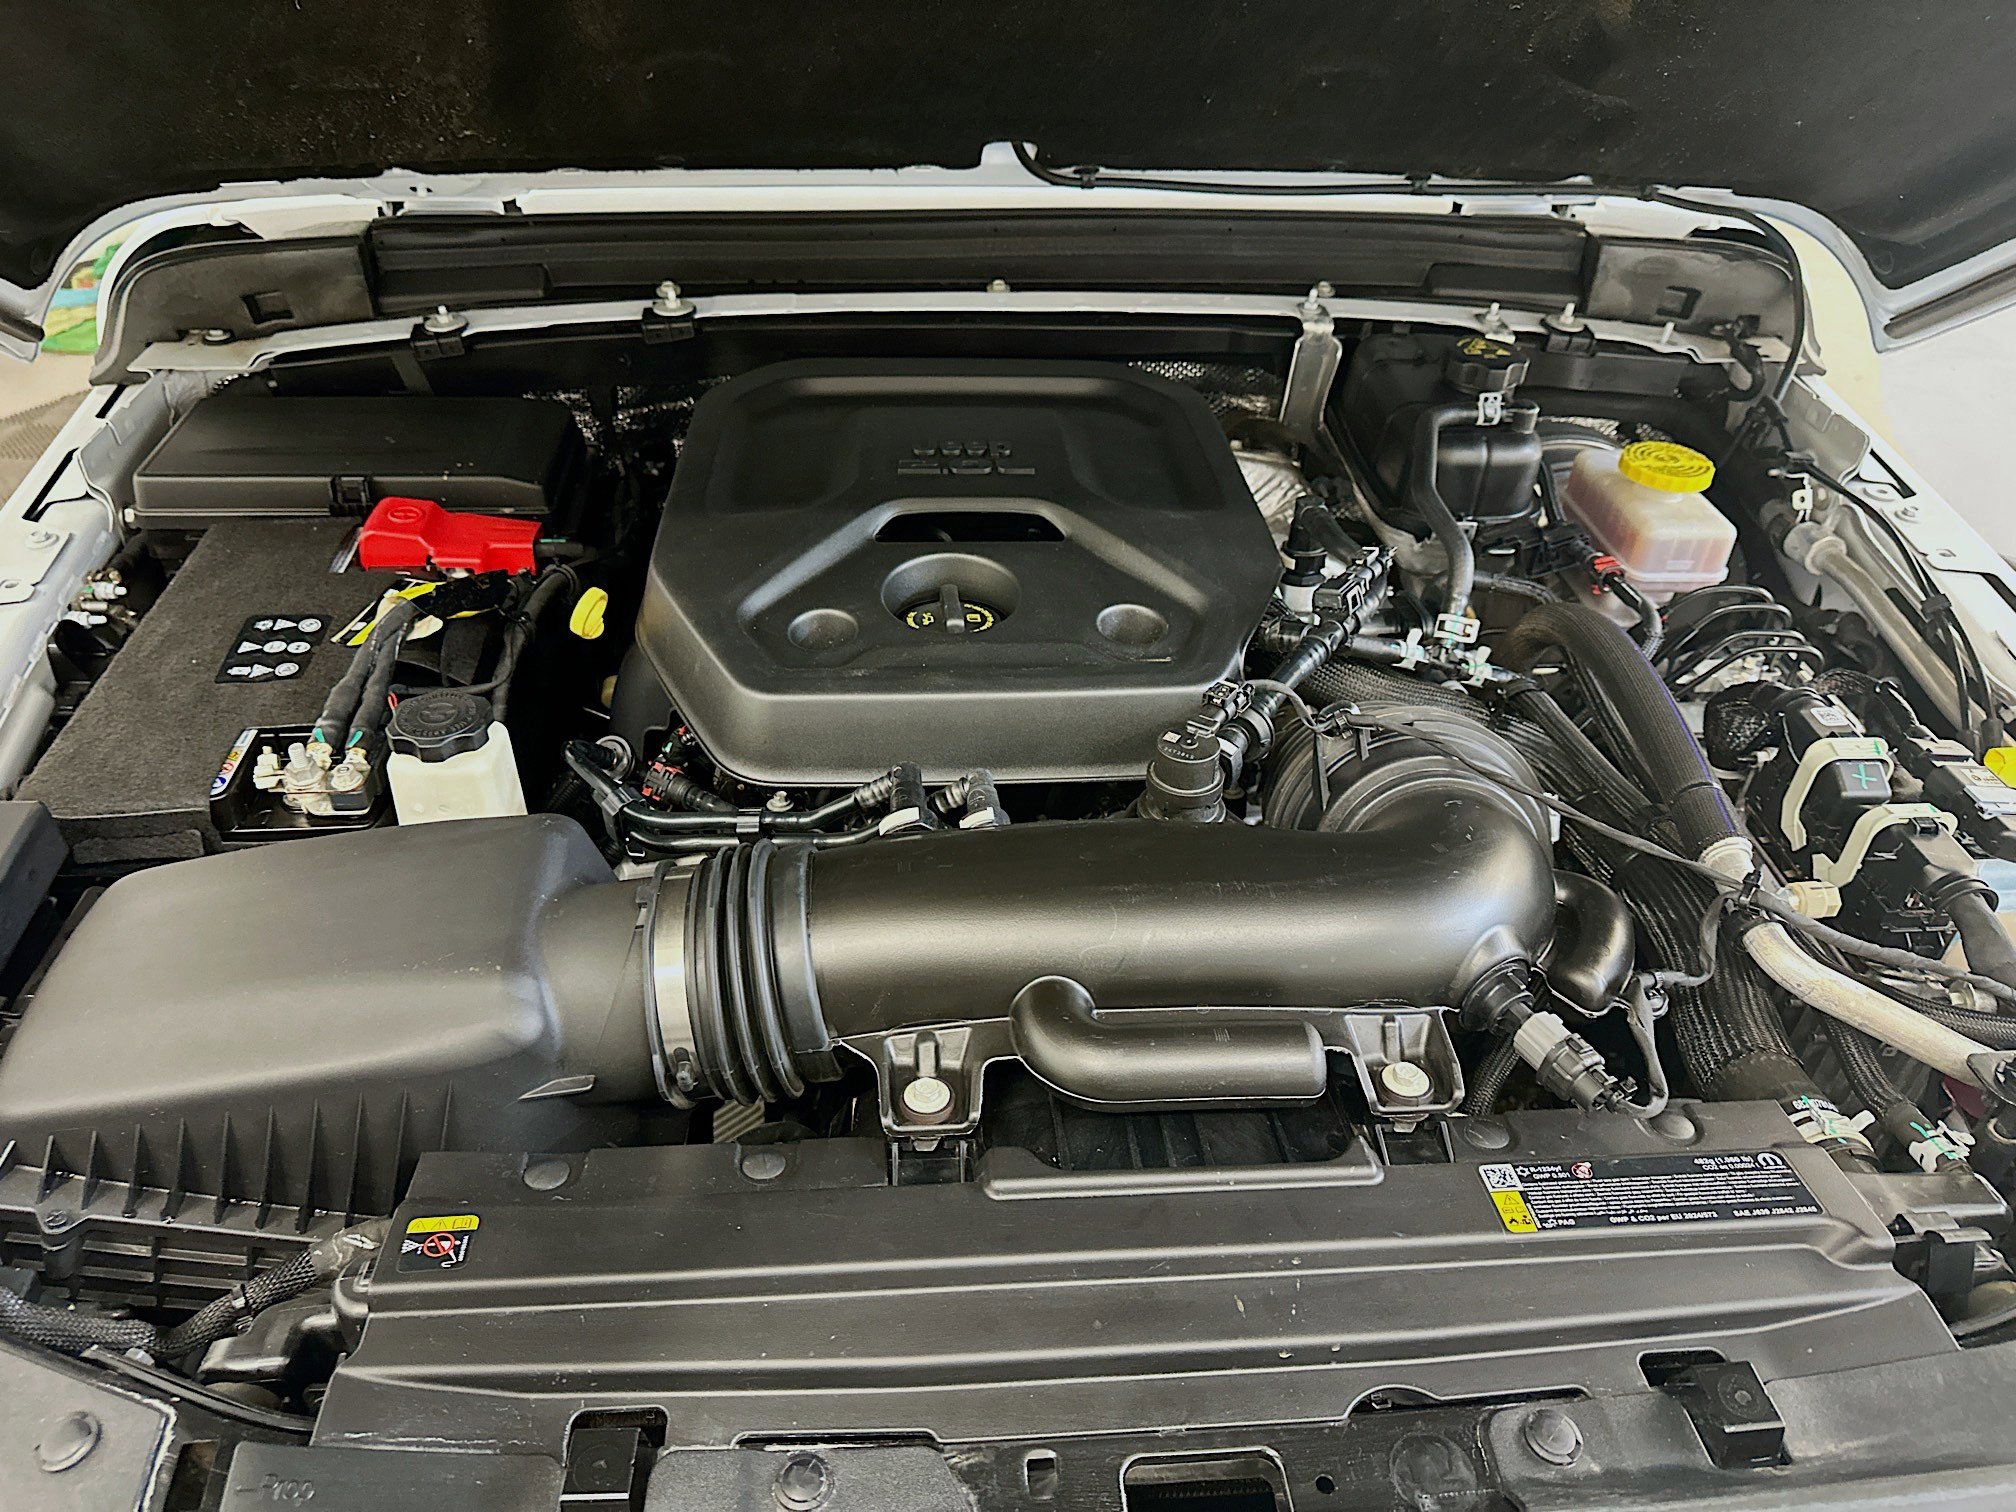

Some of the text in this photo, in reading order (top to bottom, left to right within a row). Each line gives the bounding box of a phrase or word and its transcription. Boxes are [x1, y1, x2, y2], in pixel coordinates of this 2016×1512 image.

[1529, 1165, 1562, 1173] R-1234yf
[1732, 1209, 1752, 1218] SAE
[1557, 1218, 1576, 1226] PAG
[1609, 1215, 1629, 1224] GWP
[1630, 1215, 1639, 1223] &
[1638, 1214, 1656, 1222] CO2
[1670, 1212, 1683, 1220] EU
